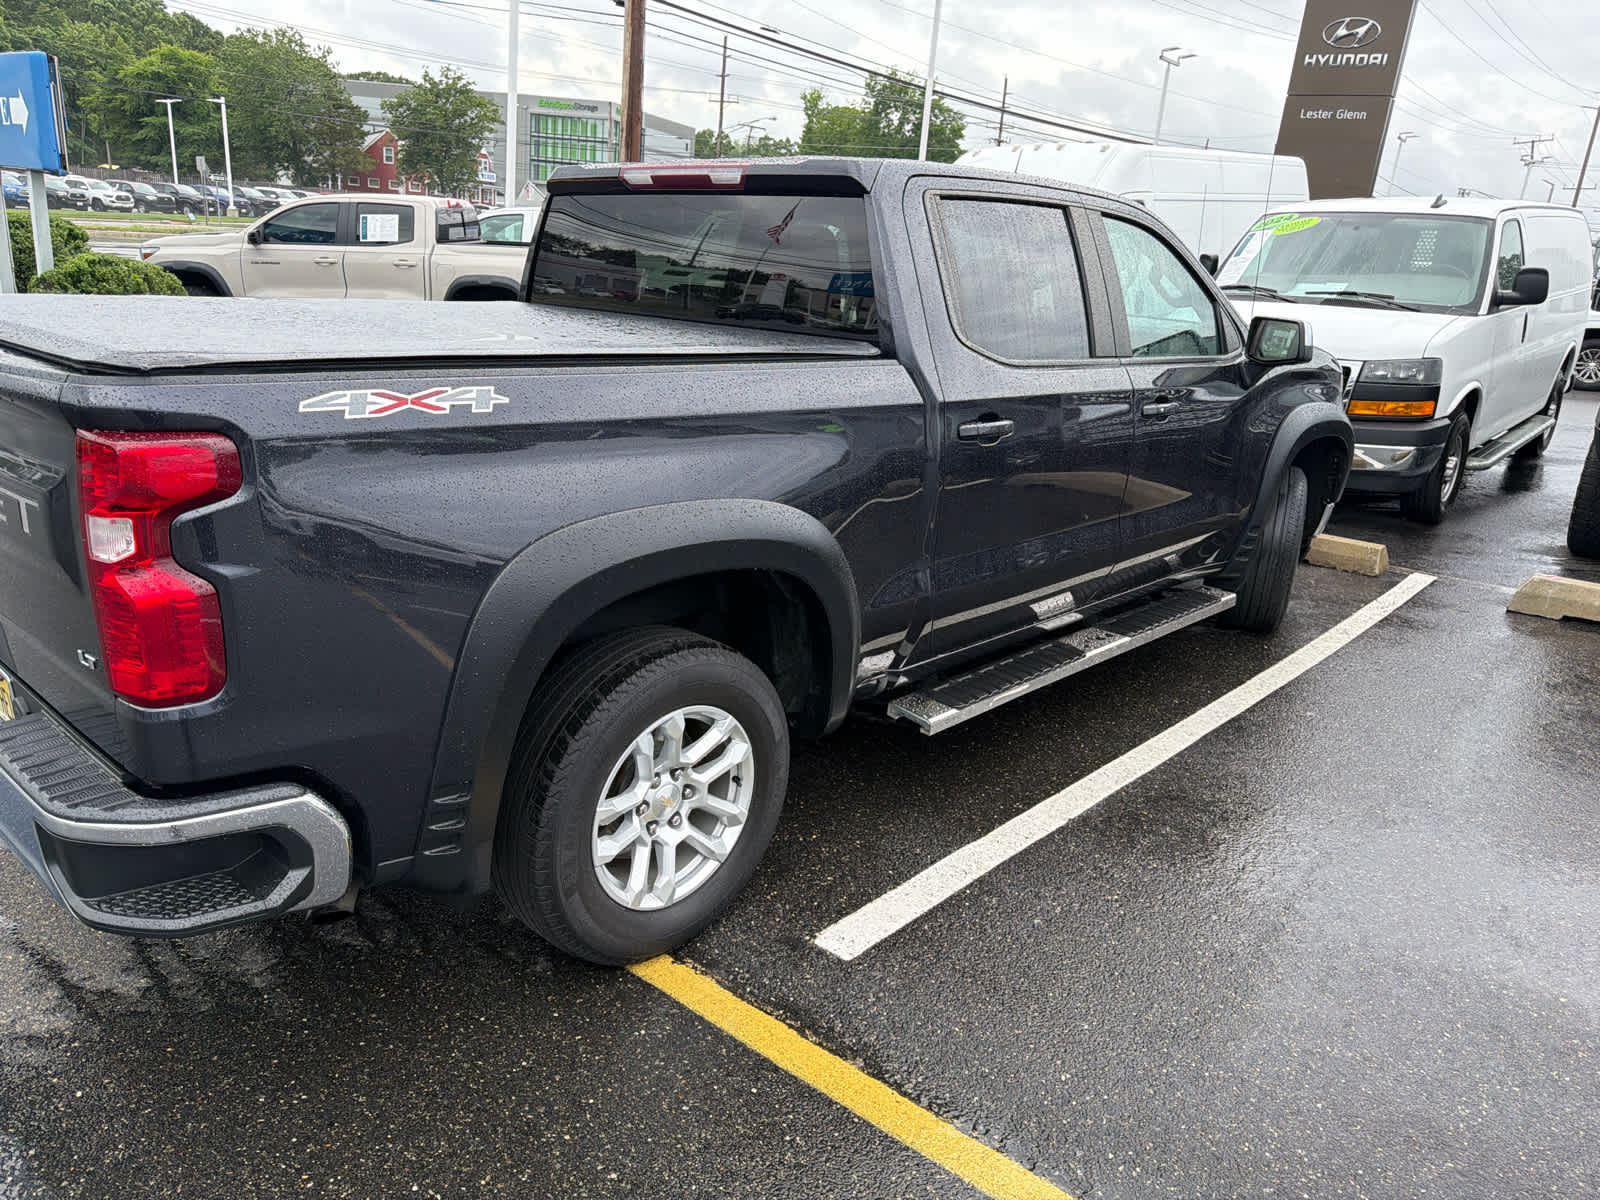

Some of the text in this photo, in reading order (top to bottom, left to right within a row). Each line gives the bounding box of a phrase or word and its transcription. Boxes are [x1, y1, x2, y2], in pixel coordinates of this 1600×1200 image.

[1304, 53, 1389, 67] HYUNDAI
[1300, 108, 1368, 120] Lester Glenn
[77, 649, 96, 671] LT
